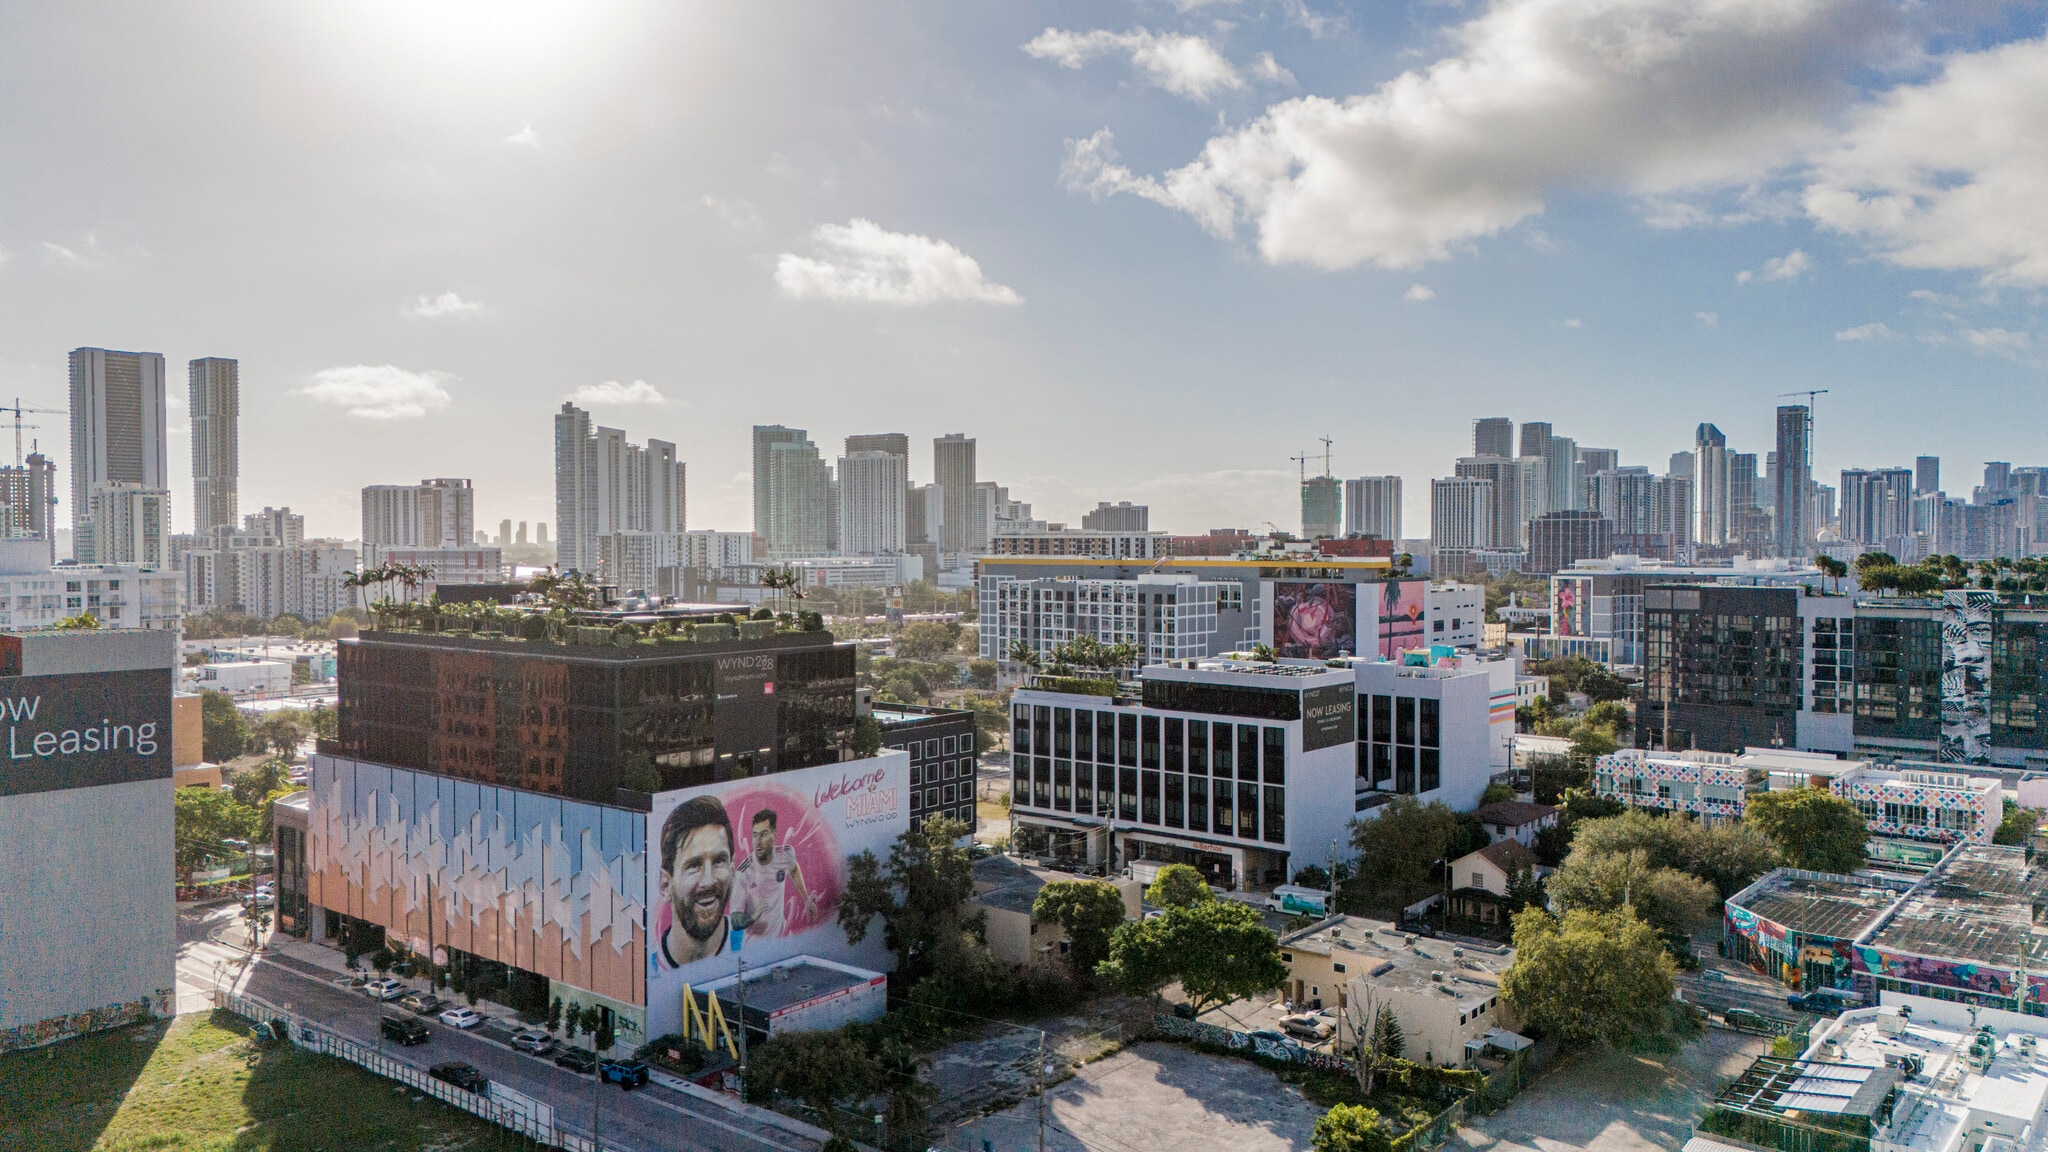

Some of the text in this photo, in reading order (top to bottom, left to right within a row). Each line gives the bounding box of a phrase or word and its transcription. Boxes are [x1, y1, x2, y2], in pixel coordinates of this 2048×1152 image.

[1306, 701, 1351, 719] NOW LEASING
[10, 719, 157, 759] Leasing
[814, 768, 885, 808] Welcome
[845, 788, 898, 819] MIAMI
[845, 812, 898, 828] WYNWOOD
